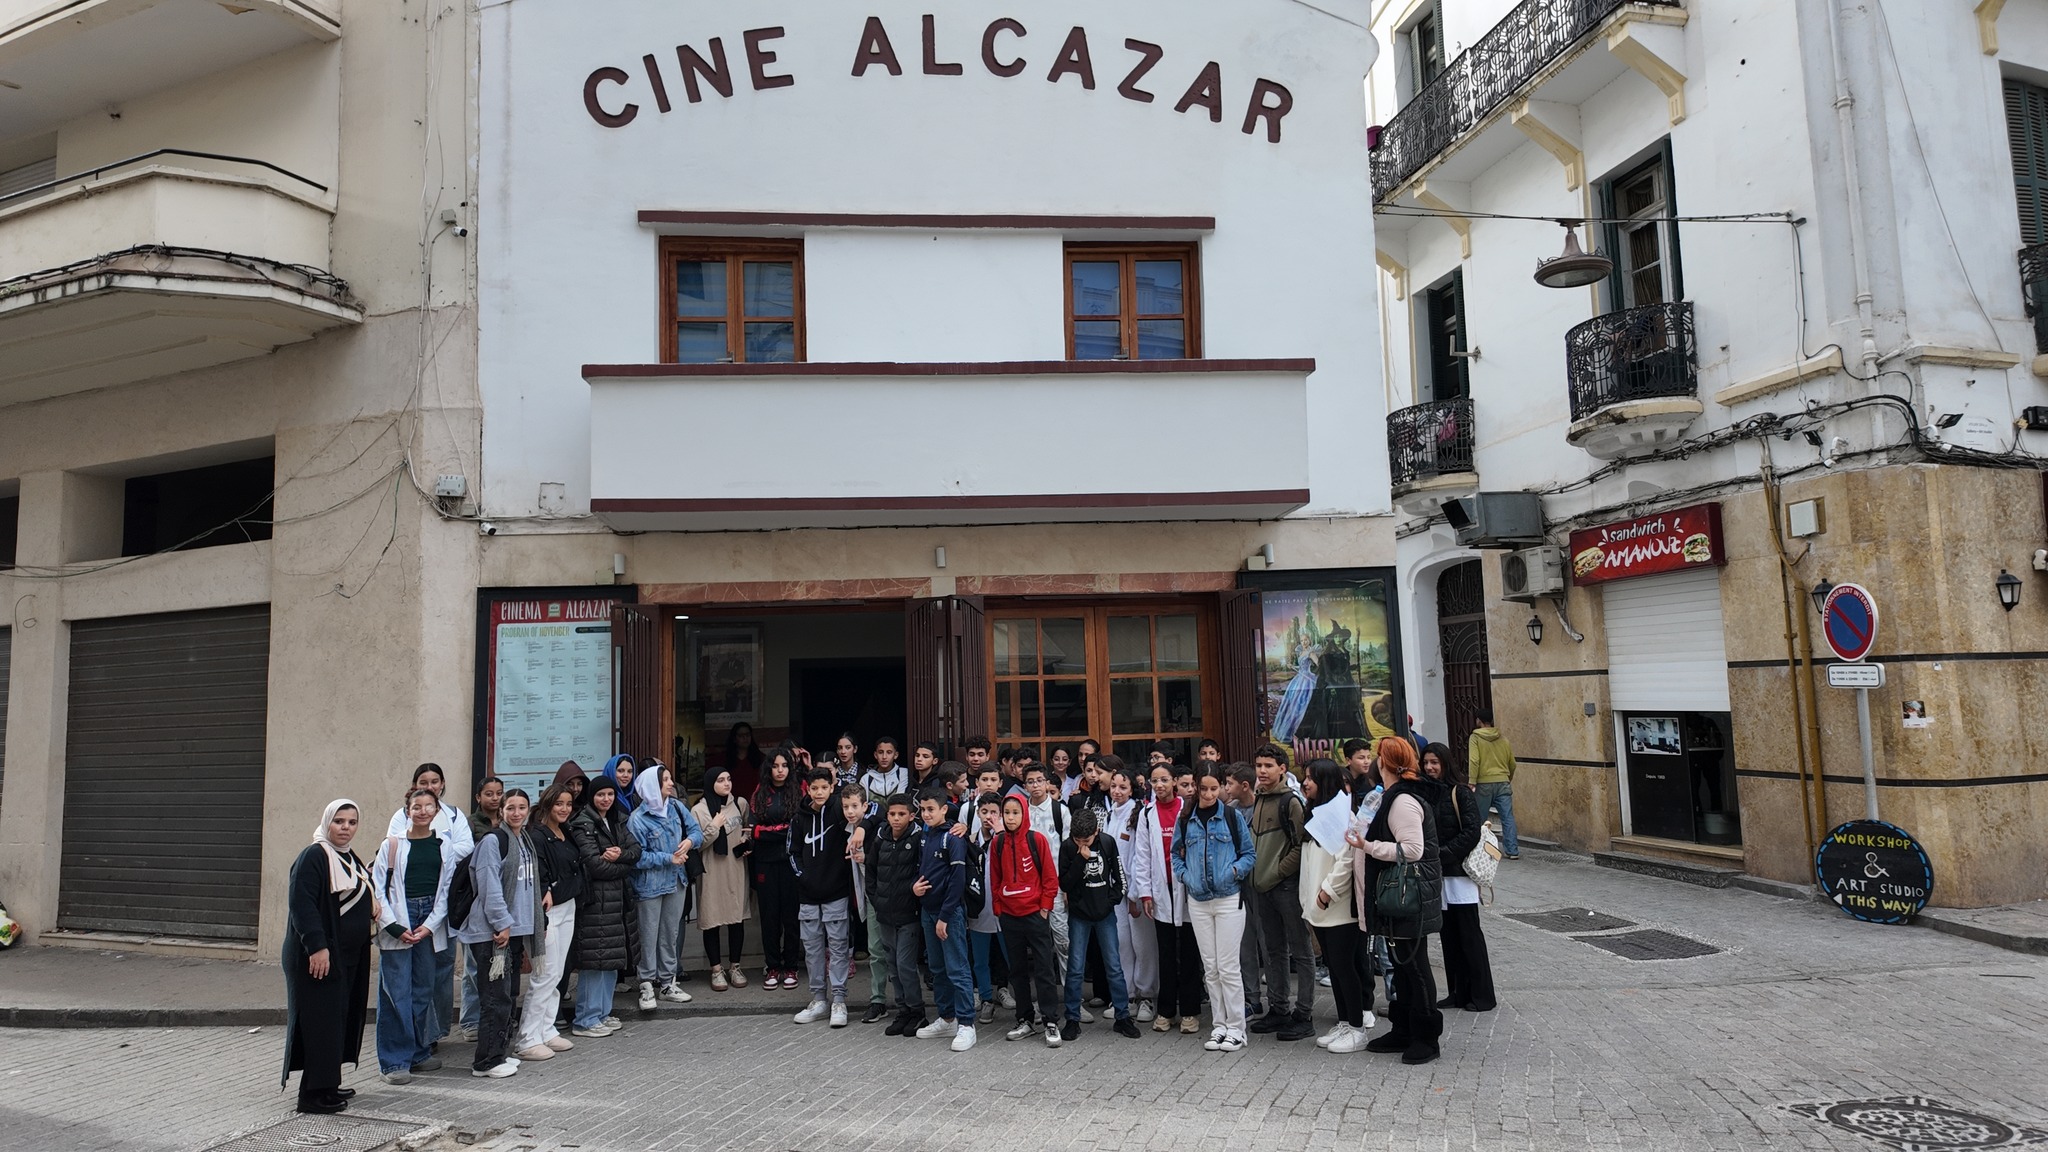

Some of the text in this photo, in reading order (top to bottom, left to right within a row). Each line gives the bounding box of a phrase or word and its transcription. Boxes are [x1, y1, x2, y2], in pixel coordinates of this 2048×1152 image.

[583, 14, 1294, 143] CINE ALCAZAR
[1610, 518, 1665, 542] sandwich
[501, 601, 542, 620] CINEMA
[1824, 587, 1872, 622] STATIONNEMENT INTERDIT
[501, 627, 529, 638] PROGRAM
[530, 627, 538, 637] OF
[539, 625, 570, 637] NOVEMBER
[1833, 833, 1911, 850] WORKSHOP
[1863, 852, 1890, 878] &
[1835, 877, 1868, 892] ART
[1847, 895, 1916, 915] THIS WAY!
